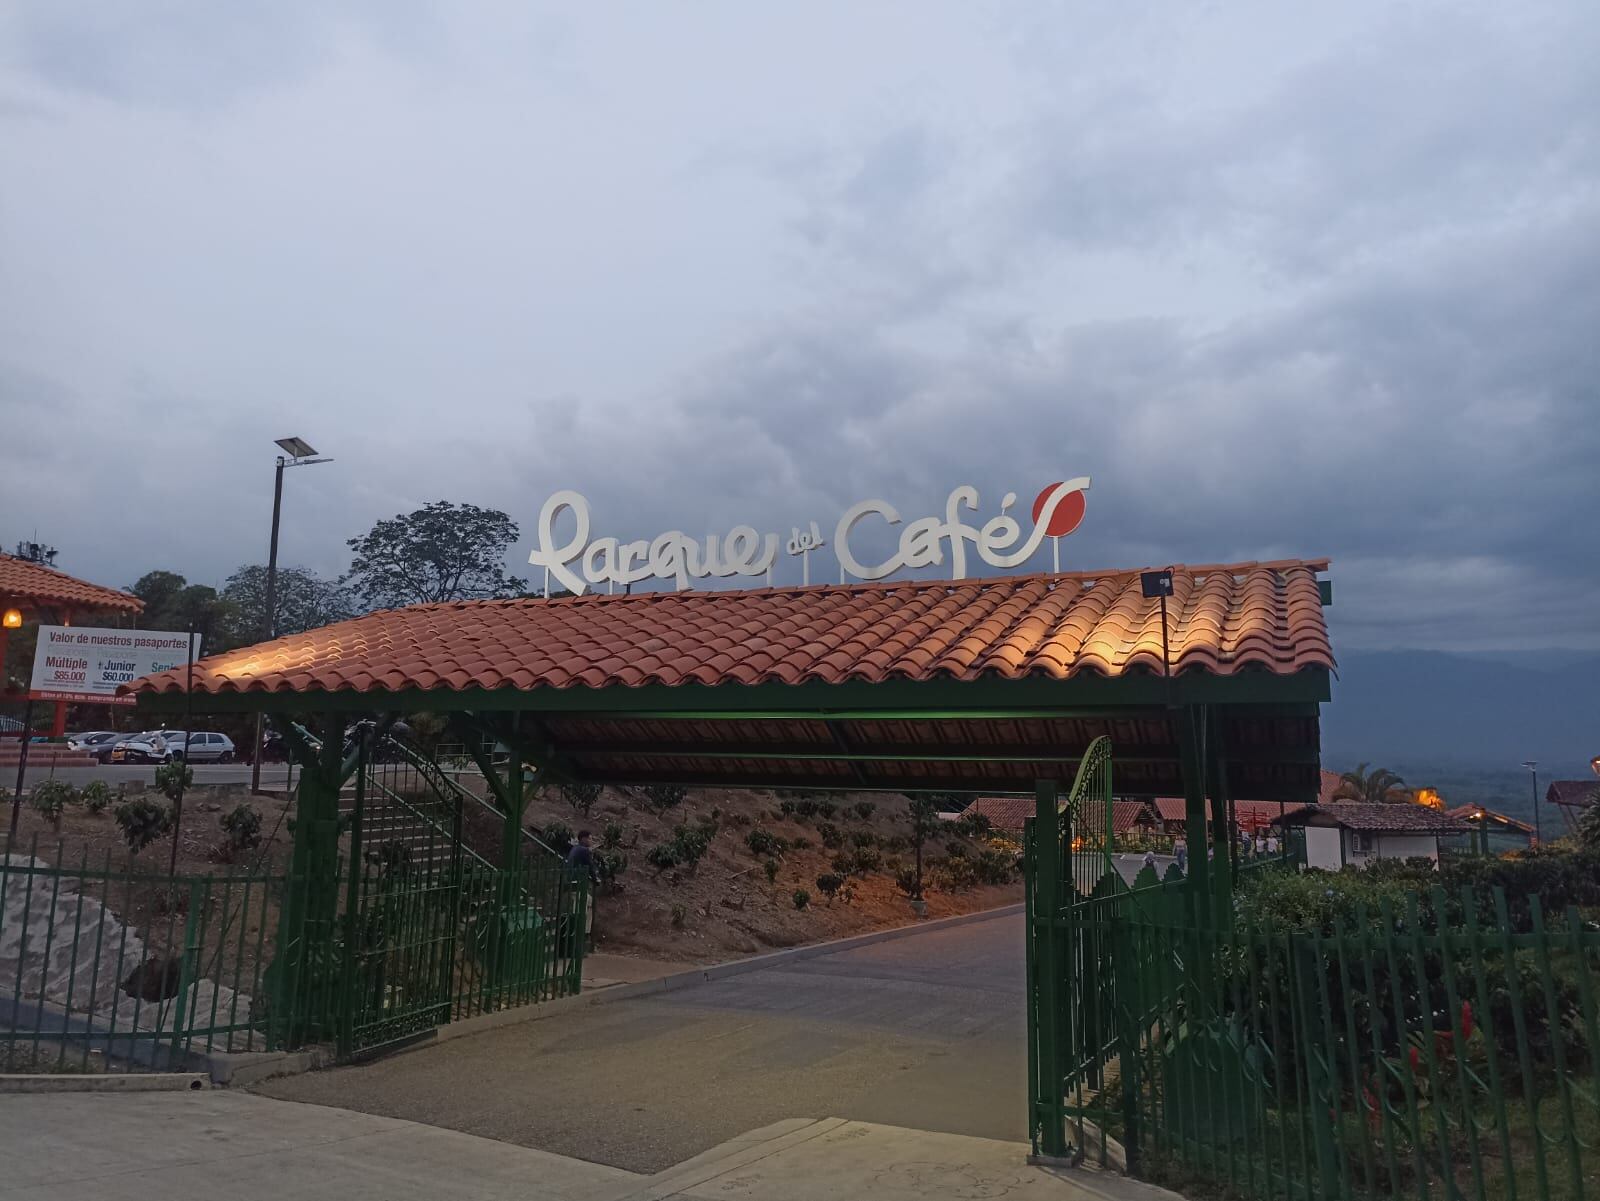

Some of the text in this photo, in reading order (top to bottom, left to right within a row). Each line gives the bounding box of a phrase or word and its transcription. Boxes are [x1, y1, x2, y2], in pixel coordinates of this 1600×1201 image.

[529, 476, 1091, 596] Parque del Café
[50, 632, 188, 650] Valor de nuestros pasaportes
[46, 656, 88, 669] Múltiple
[104, 659, 136, 672] Junior
[54, 671, 86, 681] $85.000
[102, 673, 134, 682] $60.000
